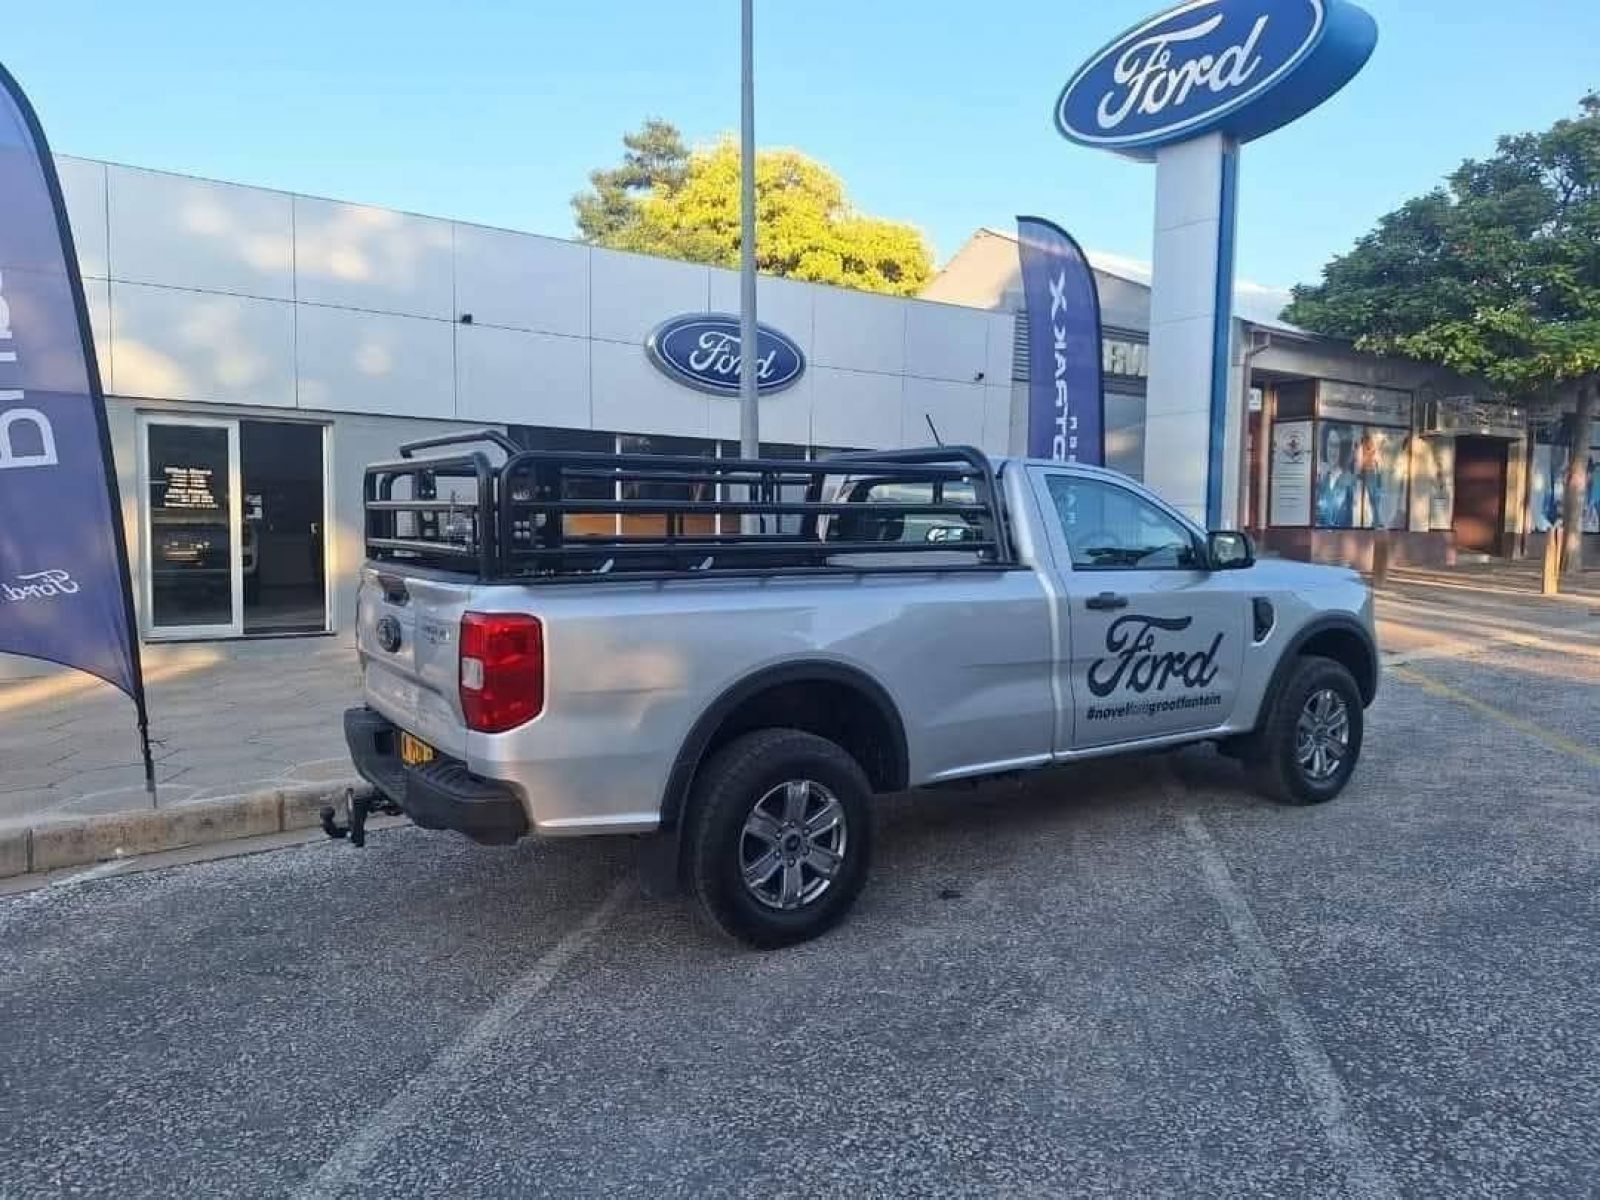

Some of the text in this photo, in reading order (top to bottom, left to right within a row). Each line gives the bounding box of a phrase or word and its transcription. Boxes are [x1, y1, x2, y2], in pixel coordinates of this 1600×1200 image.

[1097, 14, 1269, 129] Ford
[689, 331, 777, 378] Fod
[1088, 614, 1224, 697] Ford
